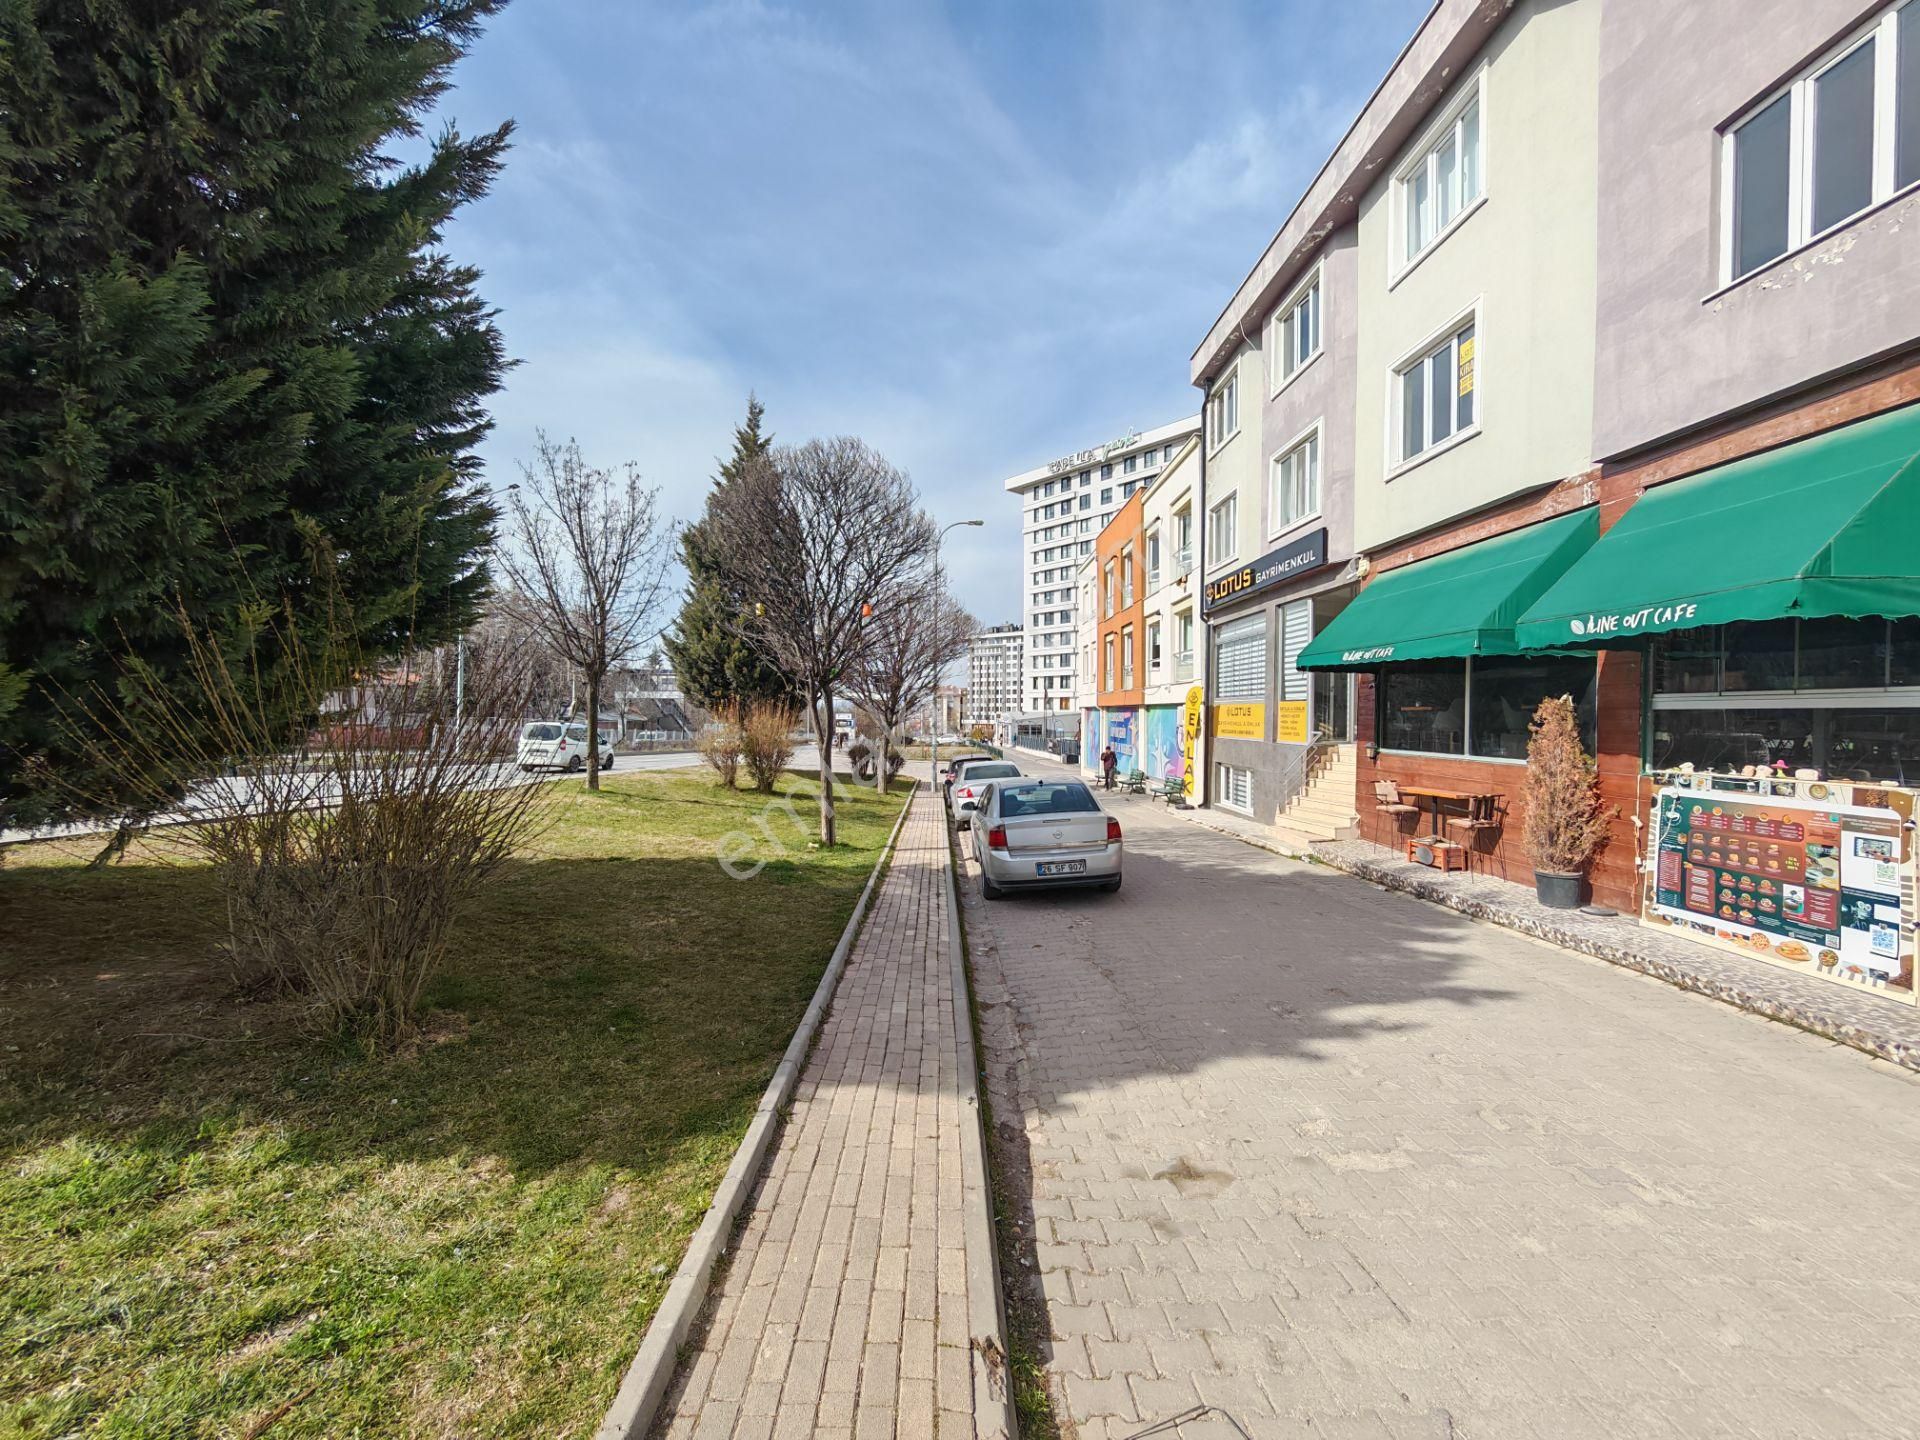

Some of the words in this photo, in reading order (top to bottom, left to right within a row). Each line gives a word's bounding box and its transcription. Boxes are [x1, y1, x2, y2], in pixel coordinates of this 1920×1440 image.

[1214, 568, 1251, 599] LOTUS
[1255, 549, 1316, 584] GAYRİMENKUL
[1623, 607, 1655, 630] OUT
[1654, 603, 1698, 625] CAFE
[1230, 707, 1252, 717] LOTUS
[1042, 865, 1052, 874] 26
[1055, 864, 1067, 873] SF
[1068, 863, 1083, 872] 907
